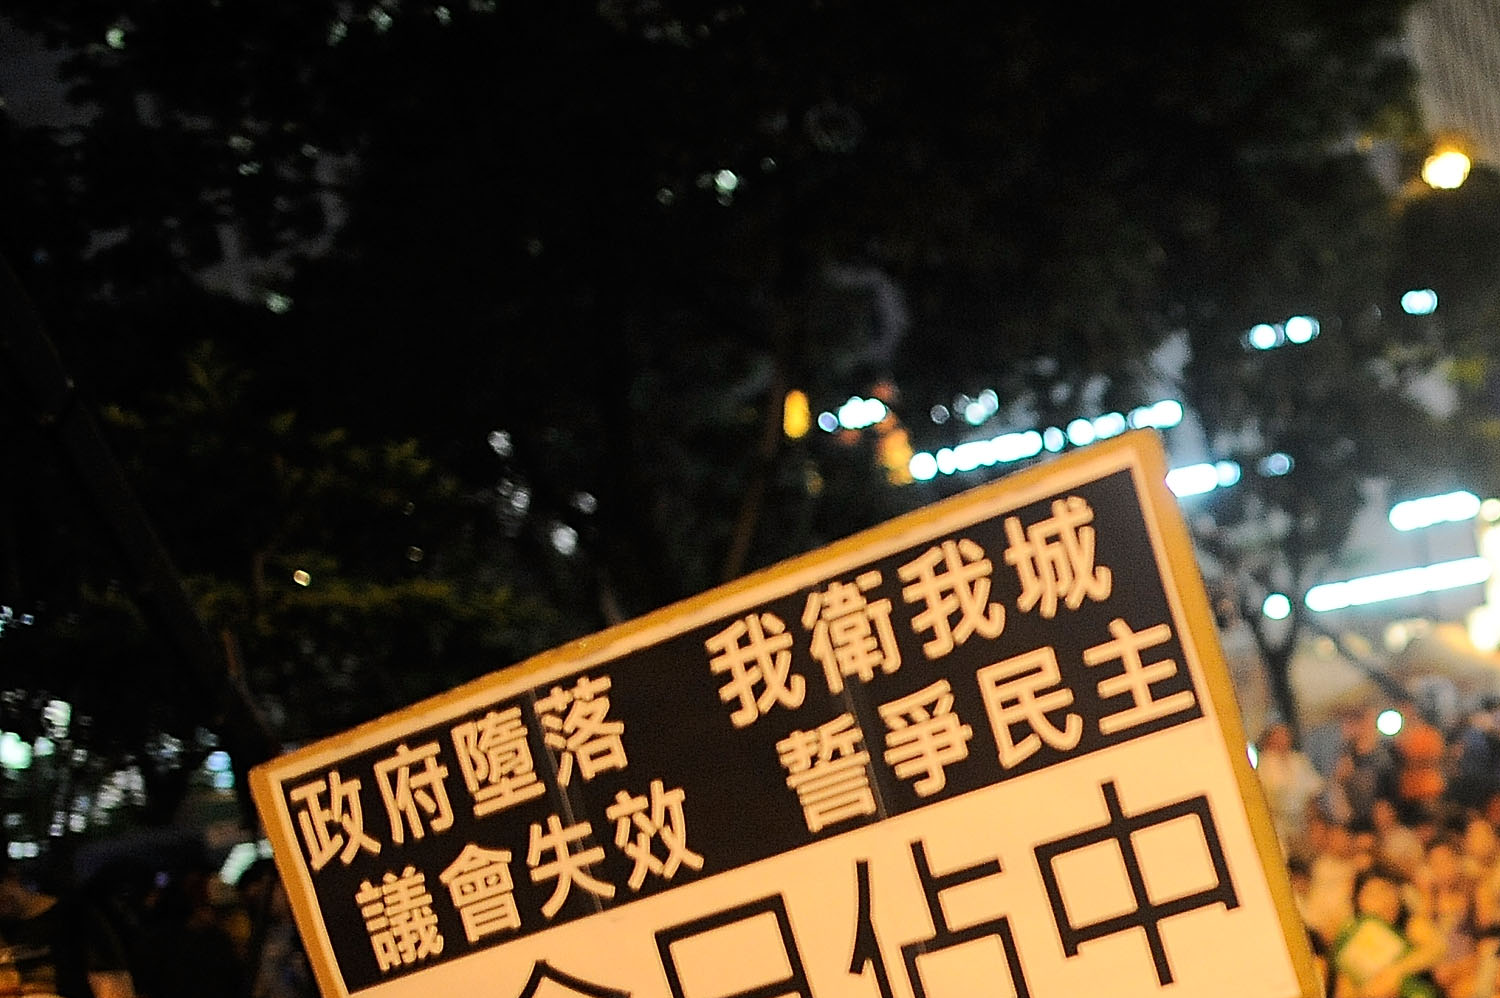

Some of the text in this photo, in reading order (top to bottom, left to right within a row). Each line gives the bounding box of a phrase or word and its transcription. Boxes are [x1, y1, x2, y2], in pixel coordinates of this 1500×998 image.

[290, 495, 1113, 872] 政府墮落 我衛我城
[355, 618, 1196, 972] 議會失效 誓爭民主
